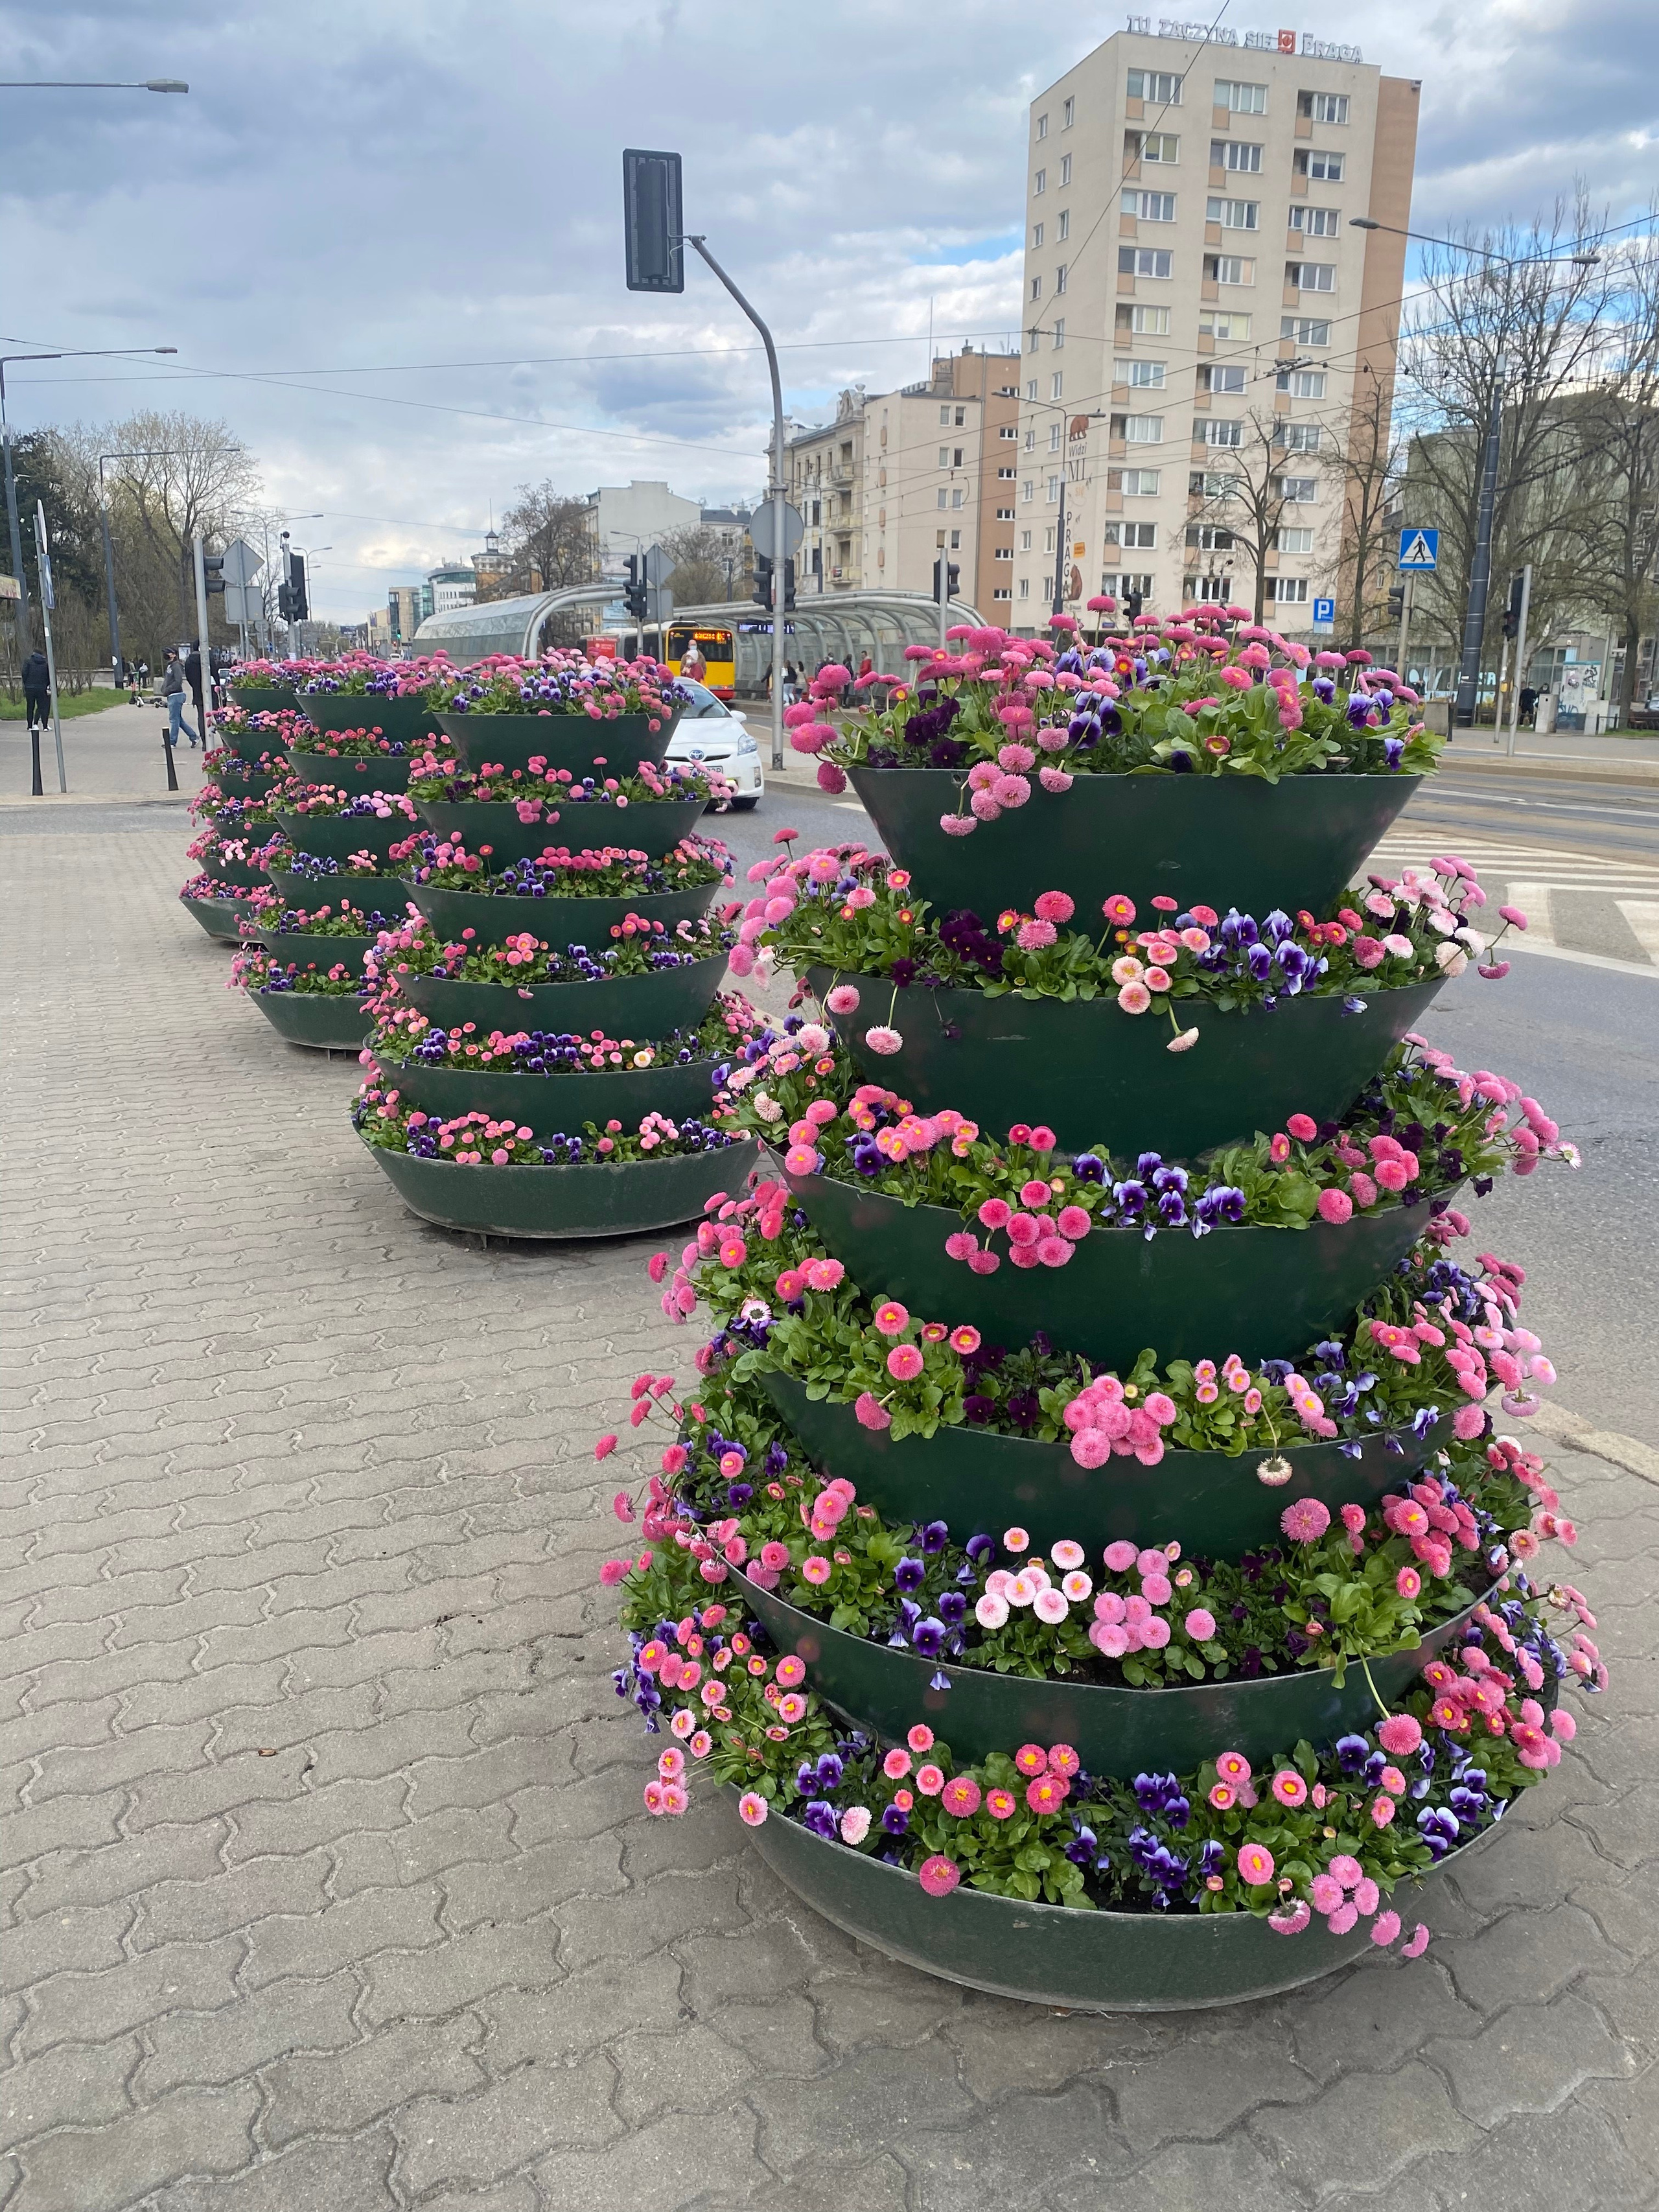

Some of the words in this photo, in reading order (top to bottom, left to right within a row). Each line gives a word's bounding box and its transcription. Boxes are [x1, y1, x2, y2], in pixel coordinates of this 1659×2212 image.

[1127, 14, 1151, 32] TU
[1159, 18, 1239, 45] ZACZYNA
[1246, 30, 1272, 50] SIĘ
[1303, 38, 1363, 62] PRAGA
[1069, 441, 1087, 457] Widzi
[1063, 511, 1072, 600] PRAGA
[1317, 601, 1330, 619] P
